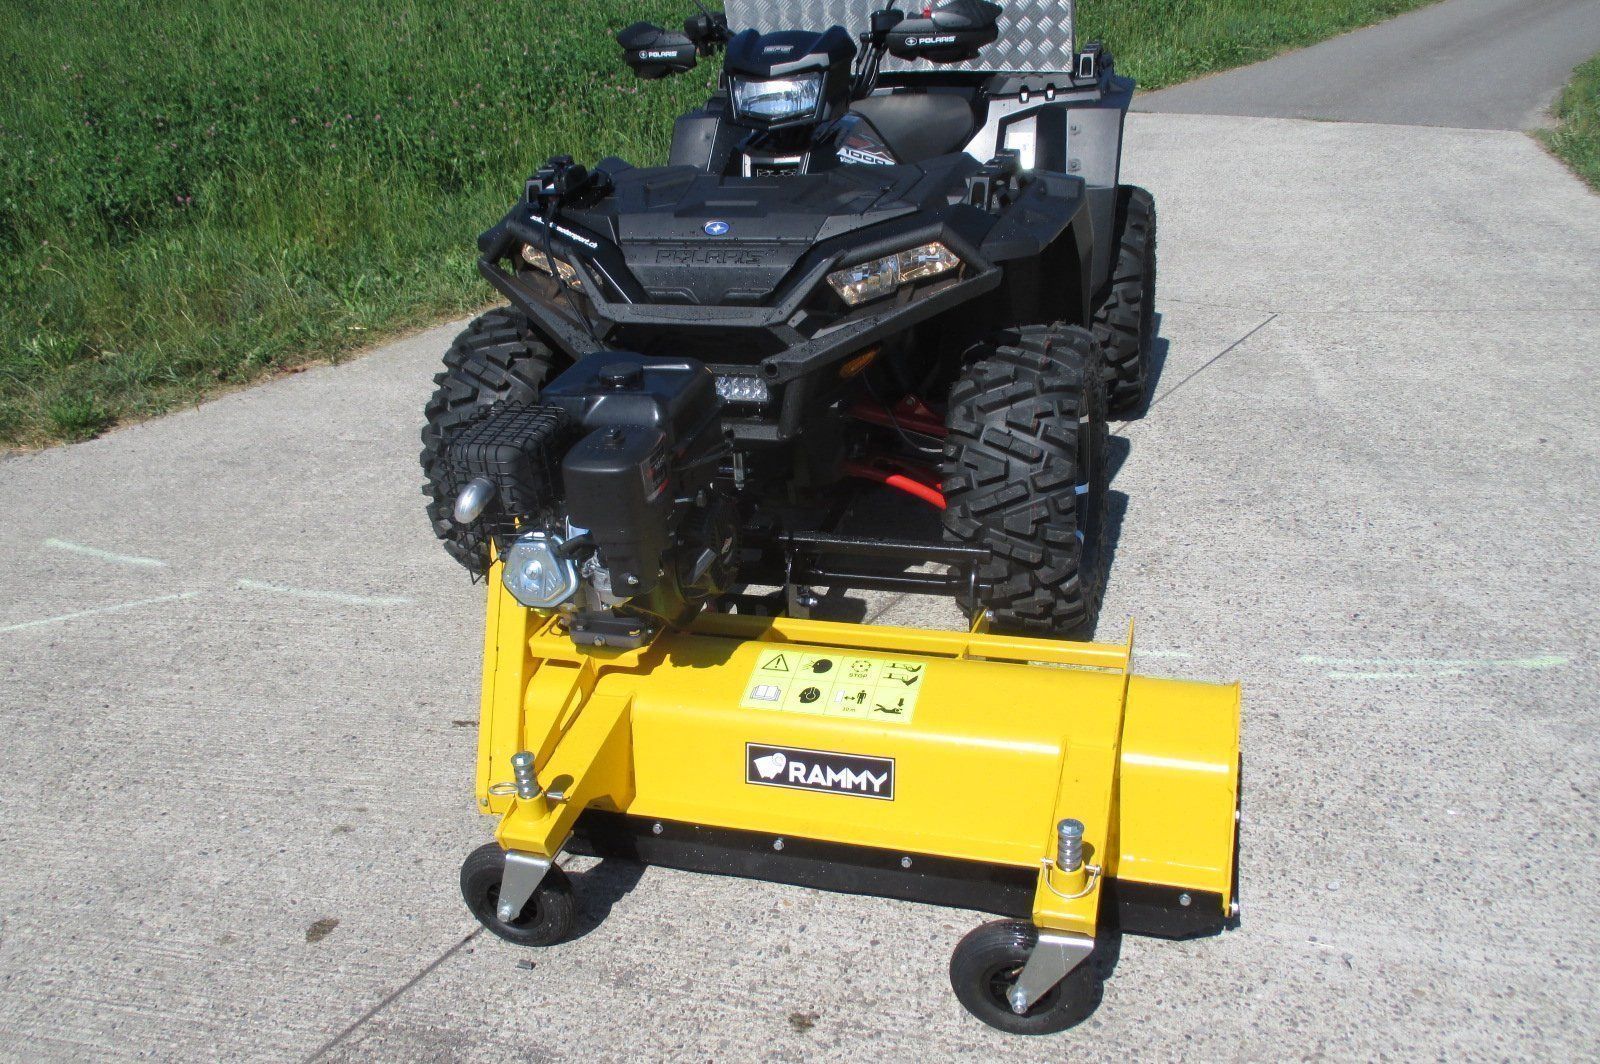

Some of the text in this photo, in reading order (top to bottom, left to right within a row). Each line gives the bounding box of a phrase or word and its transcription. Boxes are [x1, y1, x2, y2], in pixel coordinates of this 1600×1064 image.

[918, 36, 956, 44] POLARIS
[656, 249, 764, 264] POLARIS
[789, 762, 887, 792] RAMMY
